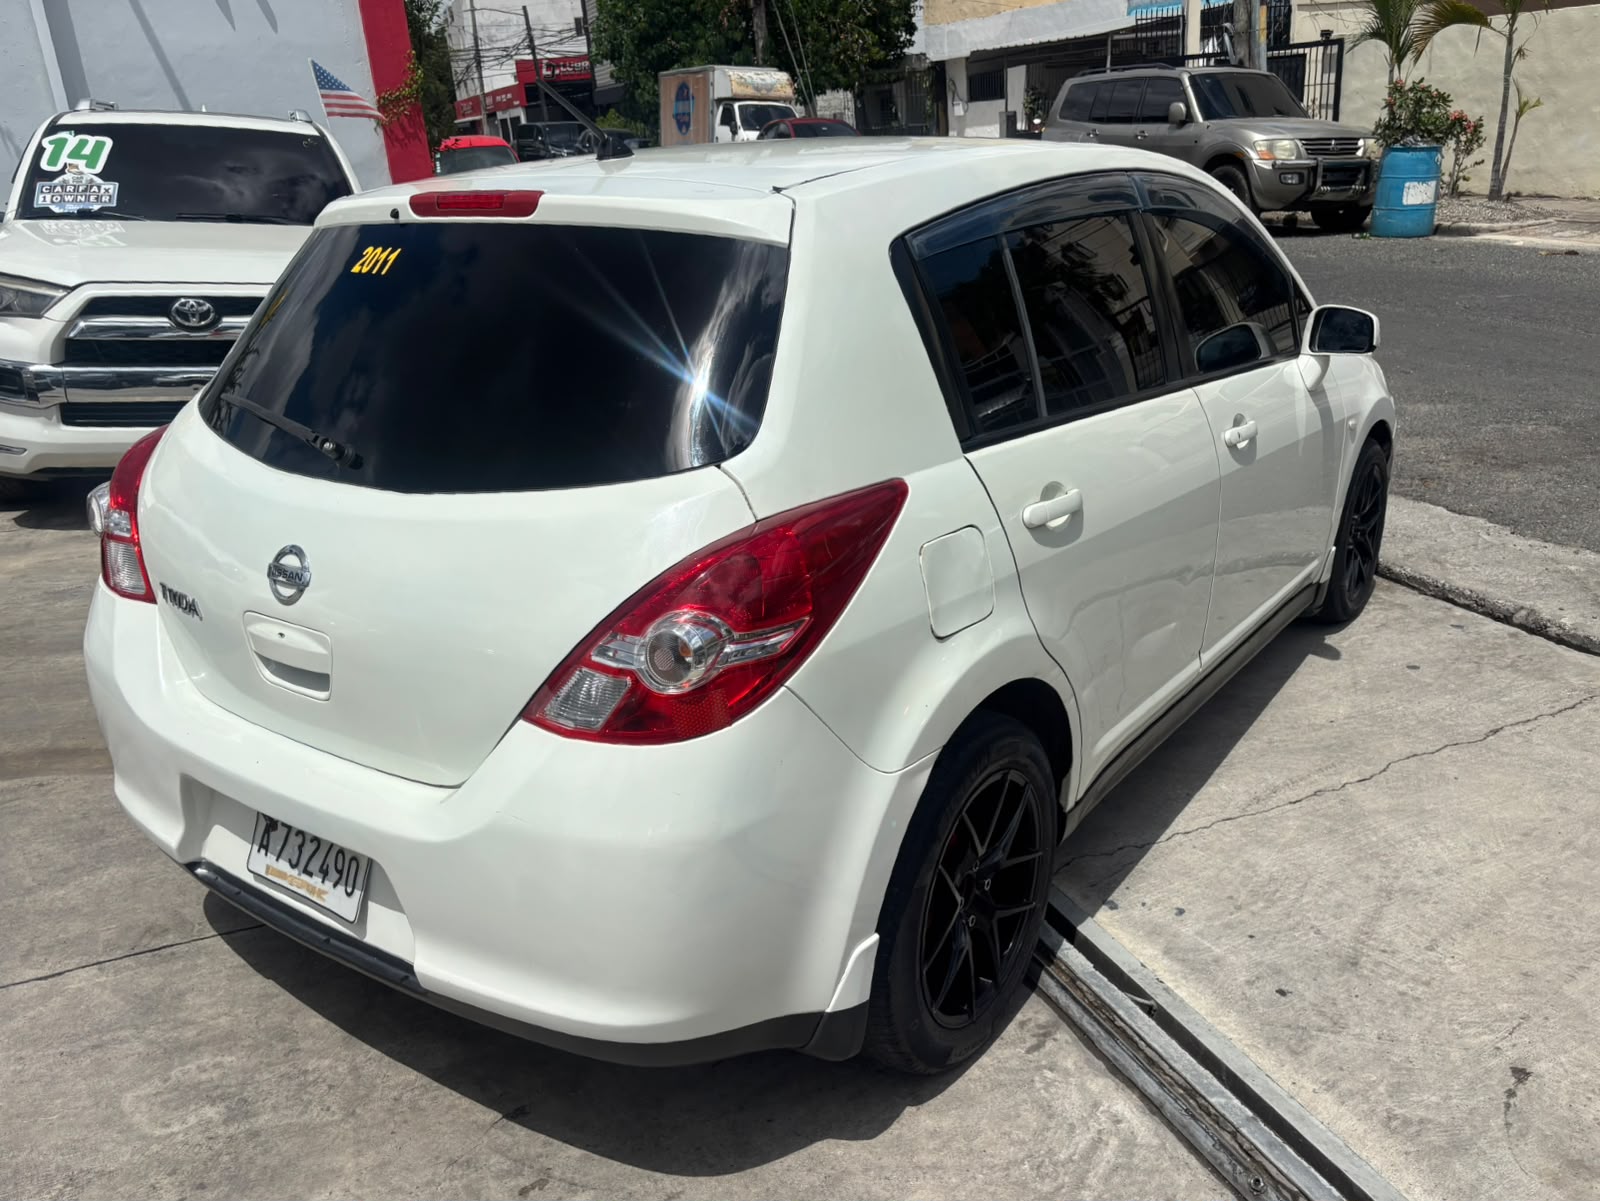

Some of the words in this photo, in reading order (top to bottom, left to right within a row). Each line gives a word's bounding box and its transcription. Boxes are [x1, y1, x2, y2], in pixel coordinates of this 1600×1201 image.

[46, 136, 107, 170] 14
[42, 185, 112, 194] CARFAX
[350, 246, 402, 275] 2011
[257, 820, 360, 898] A732490
